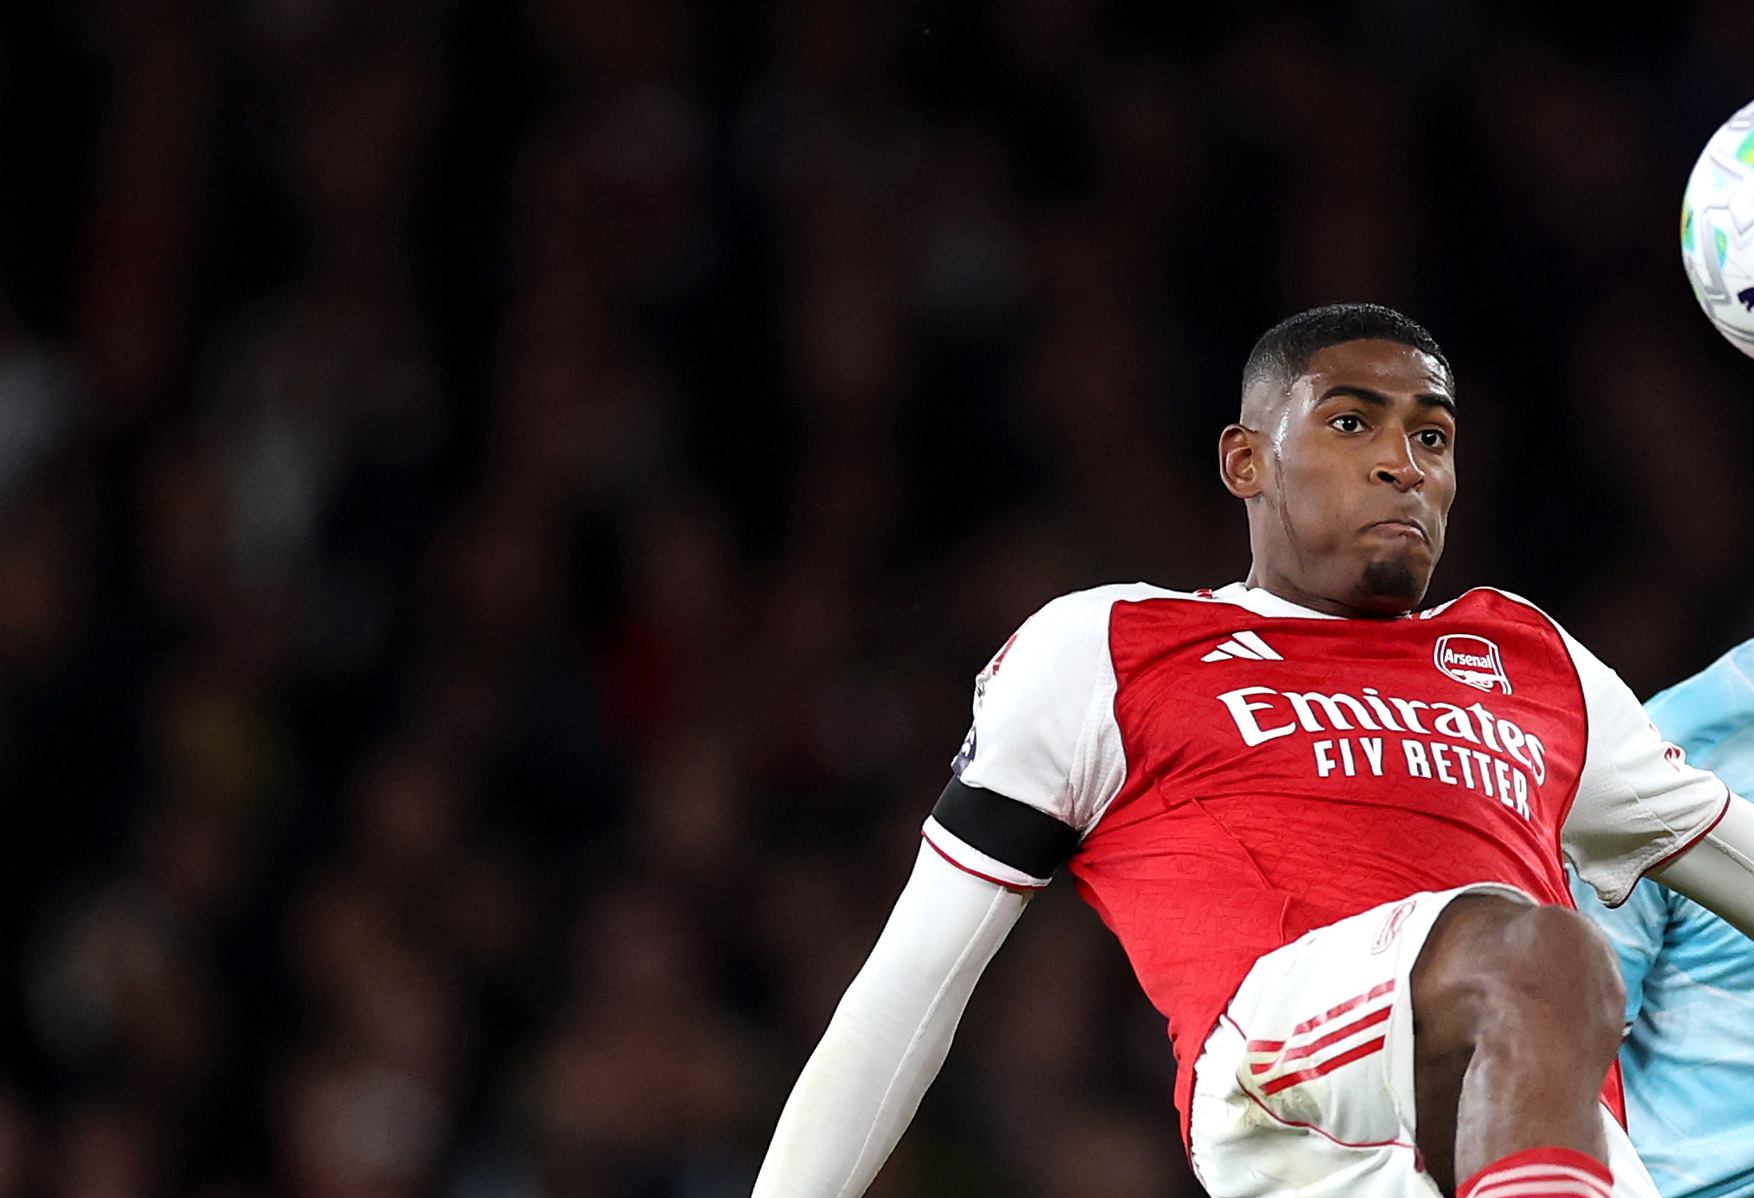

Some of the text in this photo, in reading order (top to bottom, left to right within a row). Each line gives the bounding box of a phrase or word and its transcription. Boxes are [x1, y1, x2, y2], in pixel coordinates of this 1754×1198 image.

[1444, 648, 1493, 669] Arsenal
[1216, 686, 1546, 786] Emirates
[1401, 739, 1530, 821] BETTER
